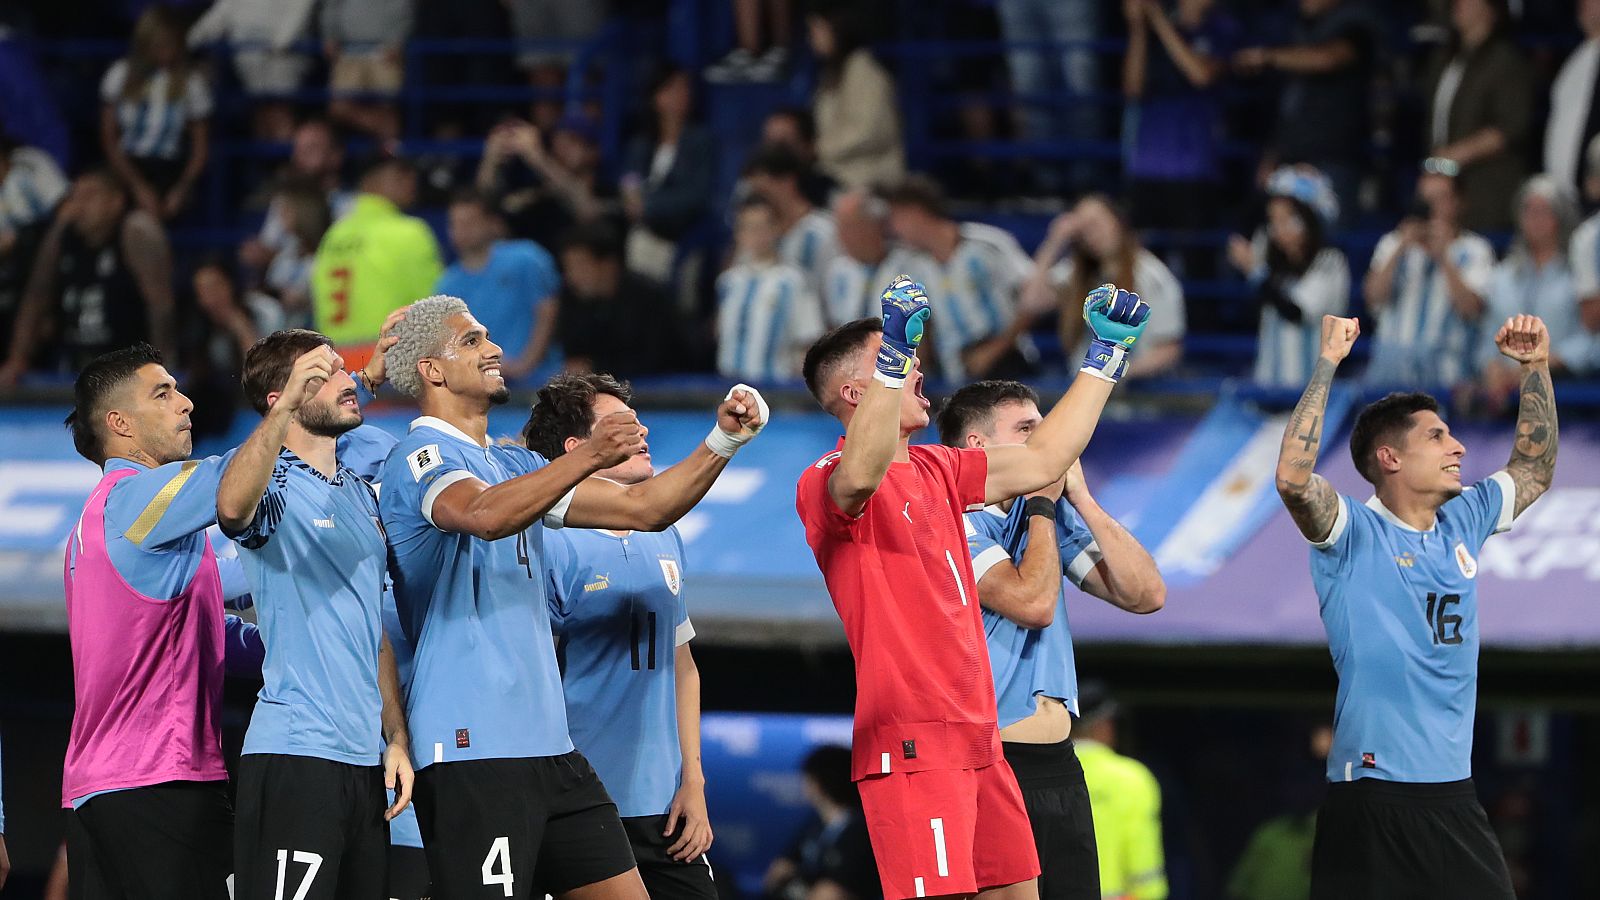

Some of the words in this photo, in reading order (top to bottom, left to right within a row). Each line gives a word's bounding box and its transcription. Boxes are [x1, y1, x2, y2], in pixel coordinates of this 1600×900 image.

[516, 530, 532, 579] 4
[945, 550, 968, 606] 1
[584, 581, 608, 592] PUMA
[630, 611, 656, 671] 11
[1426, 592, 1463, 645] 16
[274, 849, 324, 900] 17
[481, 836, 514, 897] 4
[930, 818, 949, 877] 1
